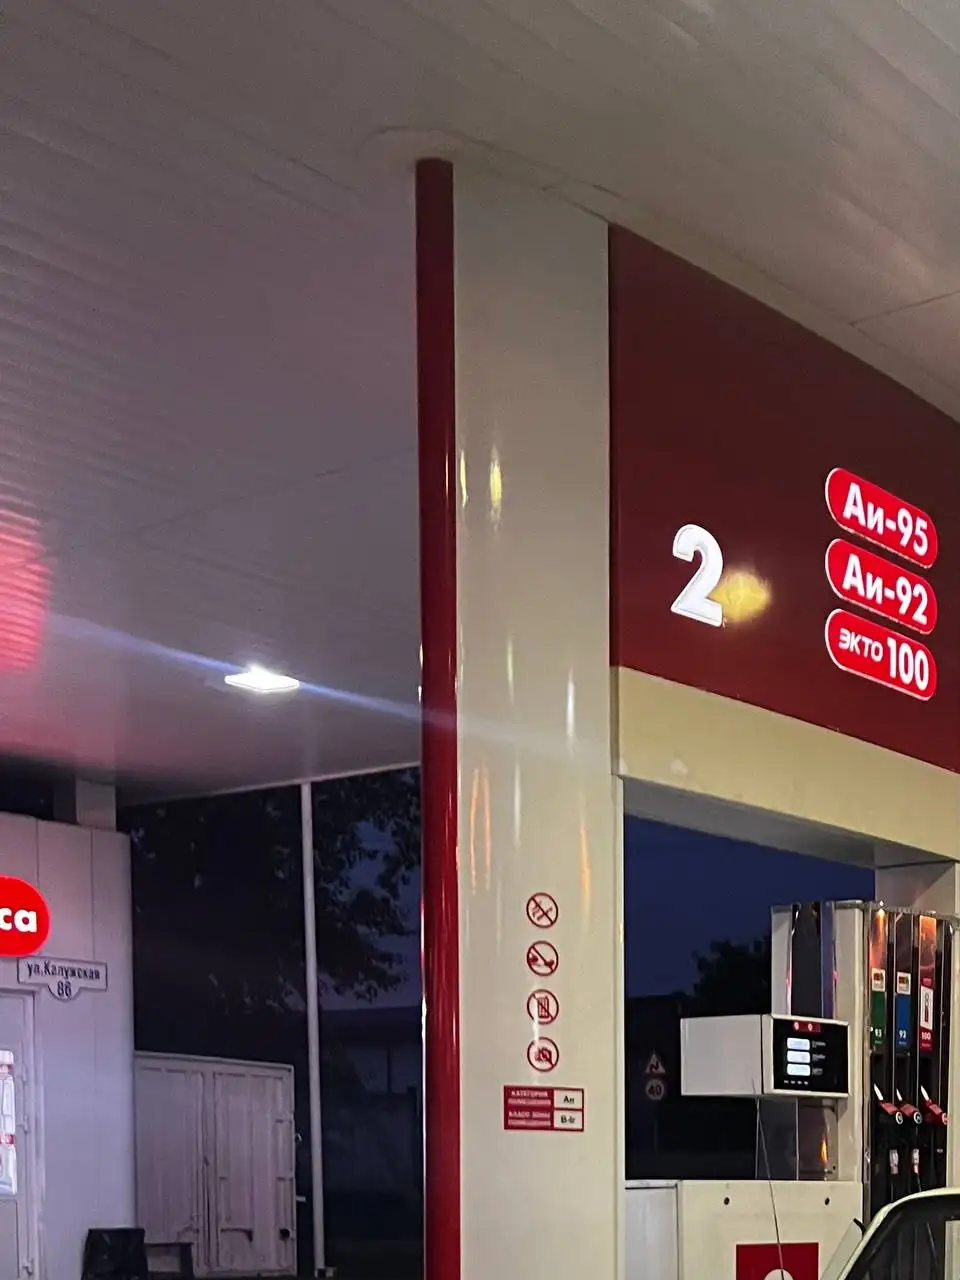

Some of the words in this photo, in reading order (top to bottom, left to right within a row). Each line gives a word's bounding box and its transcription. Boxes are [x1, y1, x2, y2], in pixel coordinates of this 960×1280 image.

[843, 482, 929, 557] Аи-95
[671, 523, 724, 628] 2
[842, 553, 929, 626] Аи-92
[887, 637, 930, 691] 100
